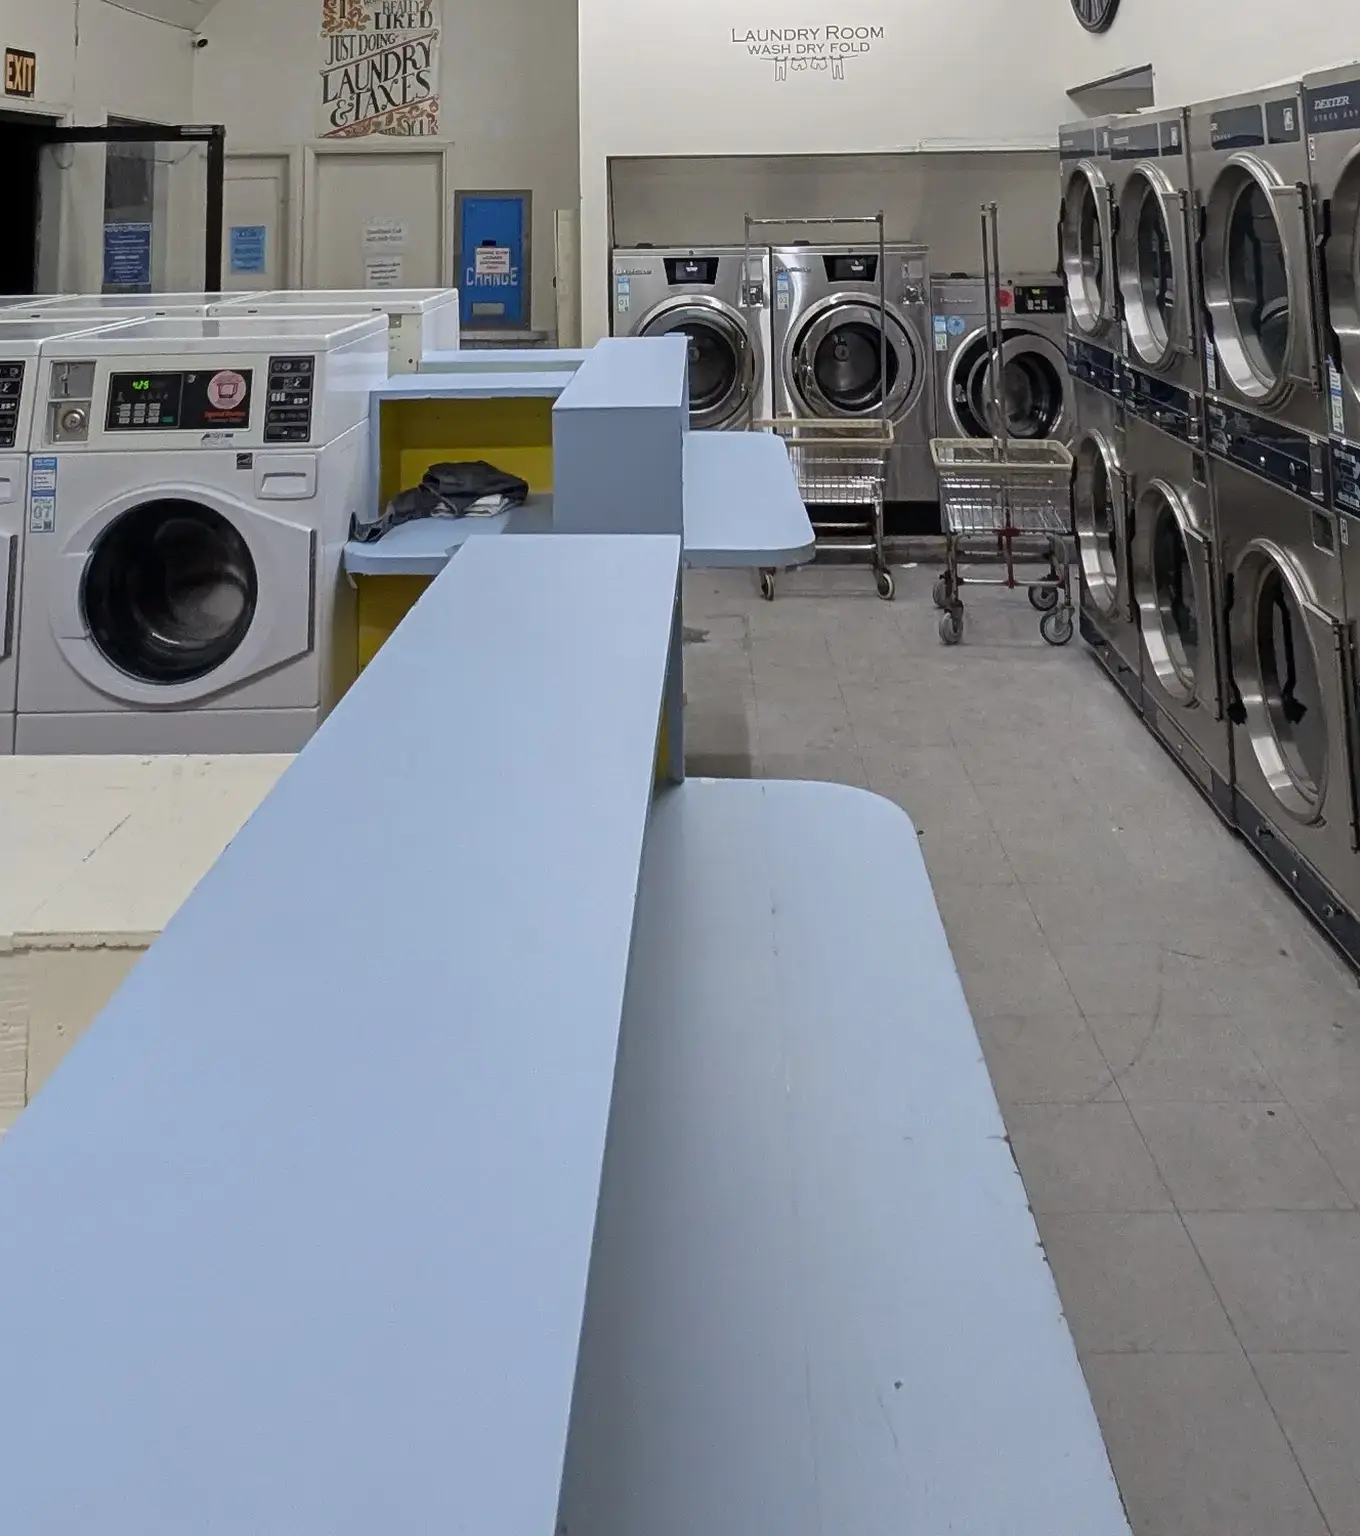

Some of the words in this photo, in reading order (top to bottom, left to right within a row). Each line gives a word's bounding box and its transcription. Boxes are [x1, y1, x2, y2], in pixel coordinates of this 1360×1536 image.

[374, 10, 434, 30] LIKED
[325, 34, 356, 65] JUST
[358, 32, 396, 56] DOING
[747, 44, 791, 55] WASH
[796, 43, 825, 54] DRY
[830, 42, 870, 53] FOLD
[6, 53, 35, 92] EXIT
[322, 41, 434, 105] LAUNDRY
[353, 69, 431, 122] TAXES
